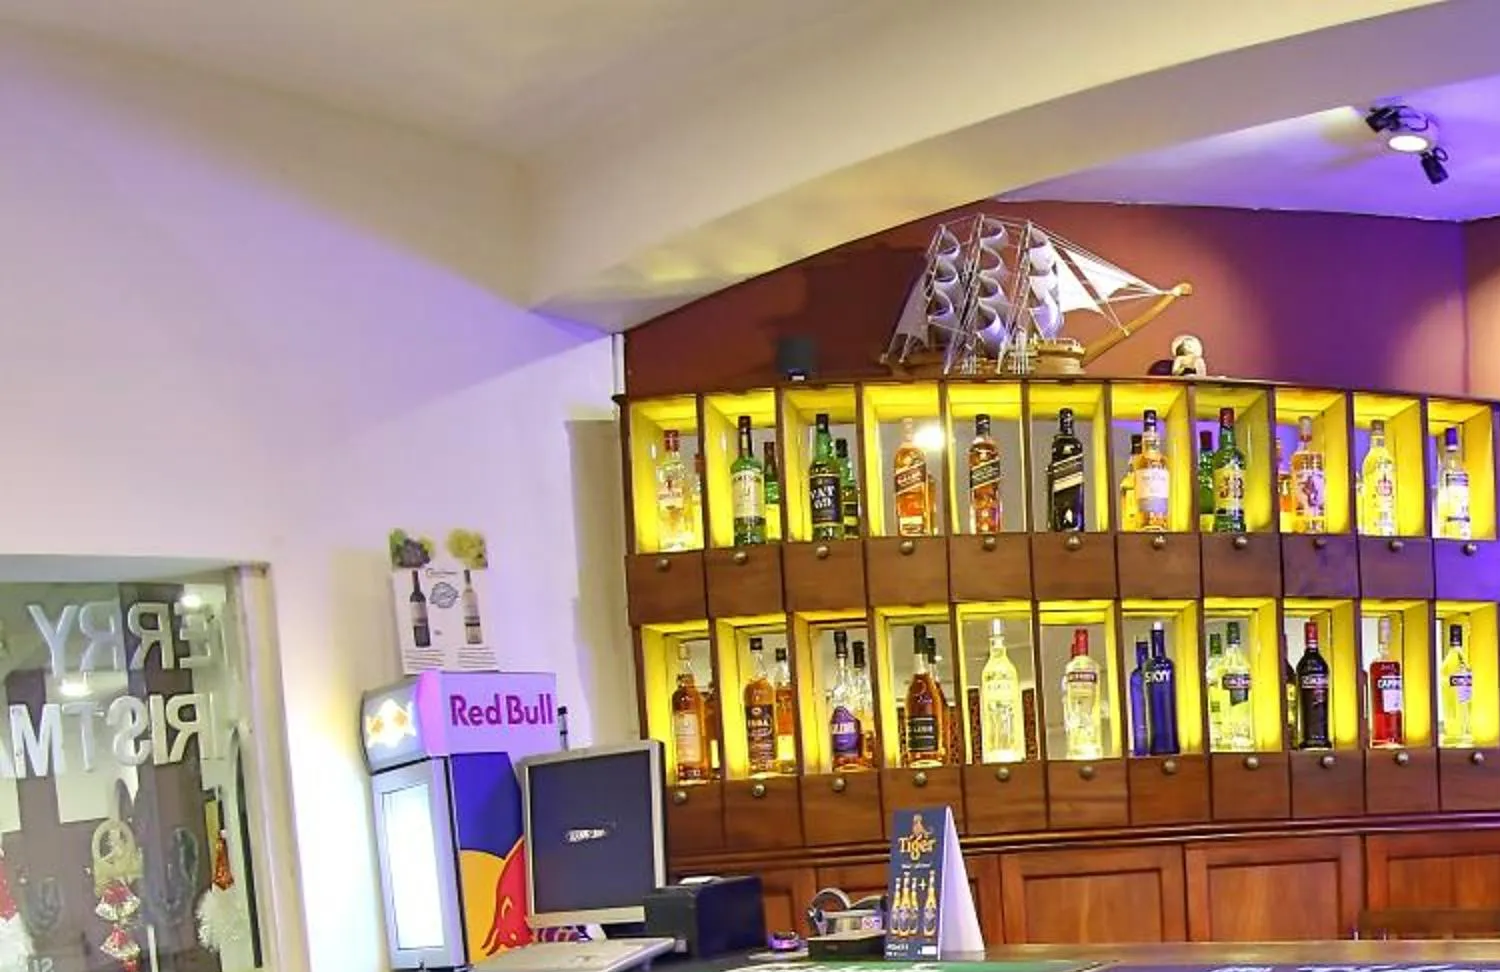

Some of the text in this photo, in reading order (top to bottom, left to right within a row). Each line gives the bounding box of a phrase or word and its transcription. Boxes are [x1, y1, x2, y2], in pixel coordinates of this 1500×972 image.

[450, 693, 554, 727] Red Bull
[898, 834, 936, 861] Tiger
